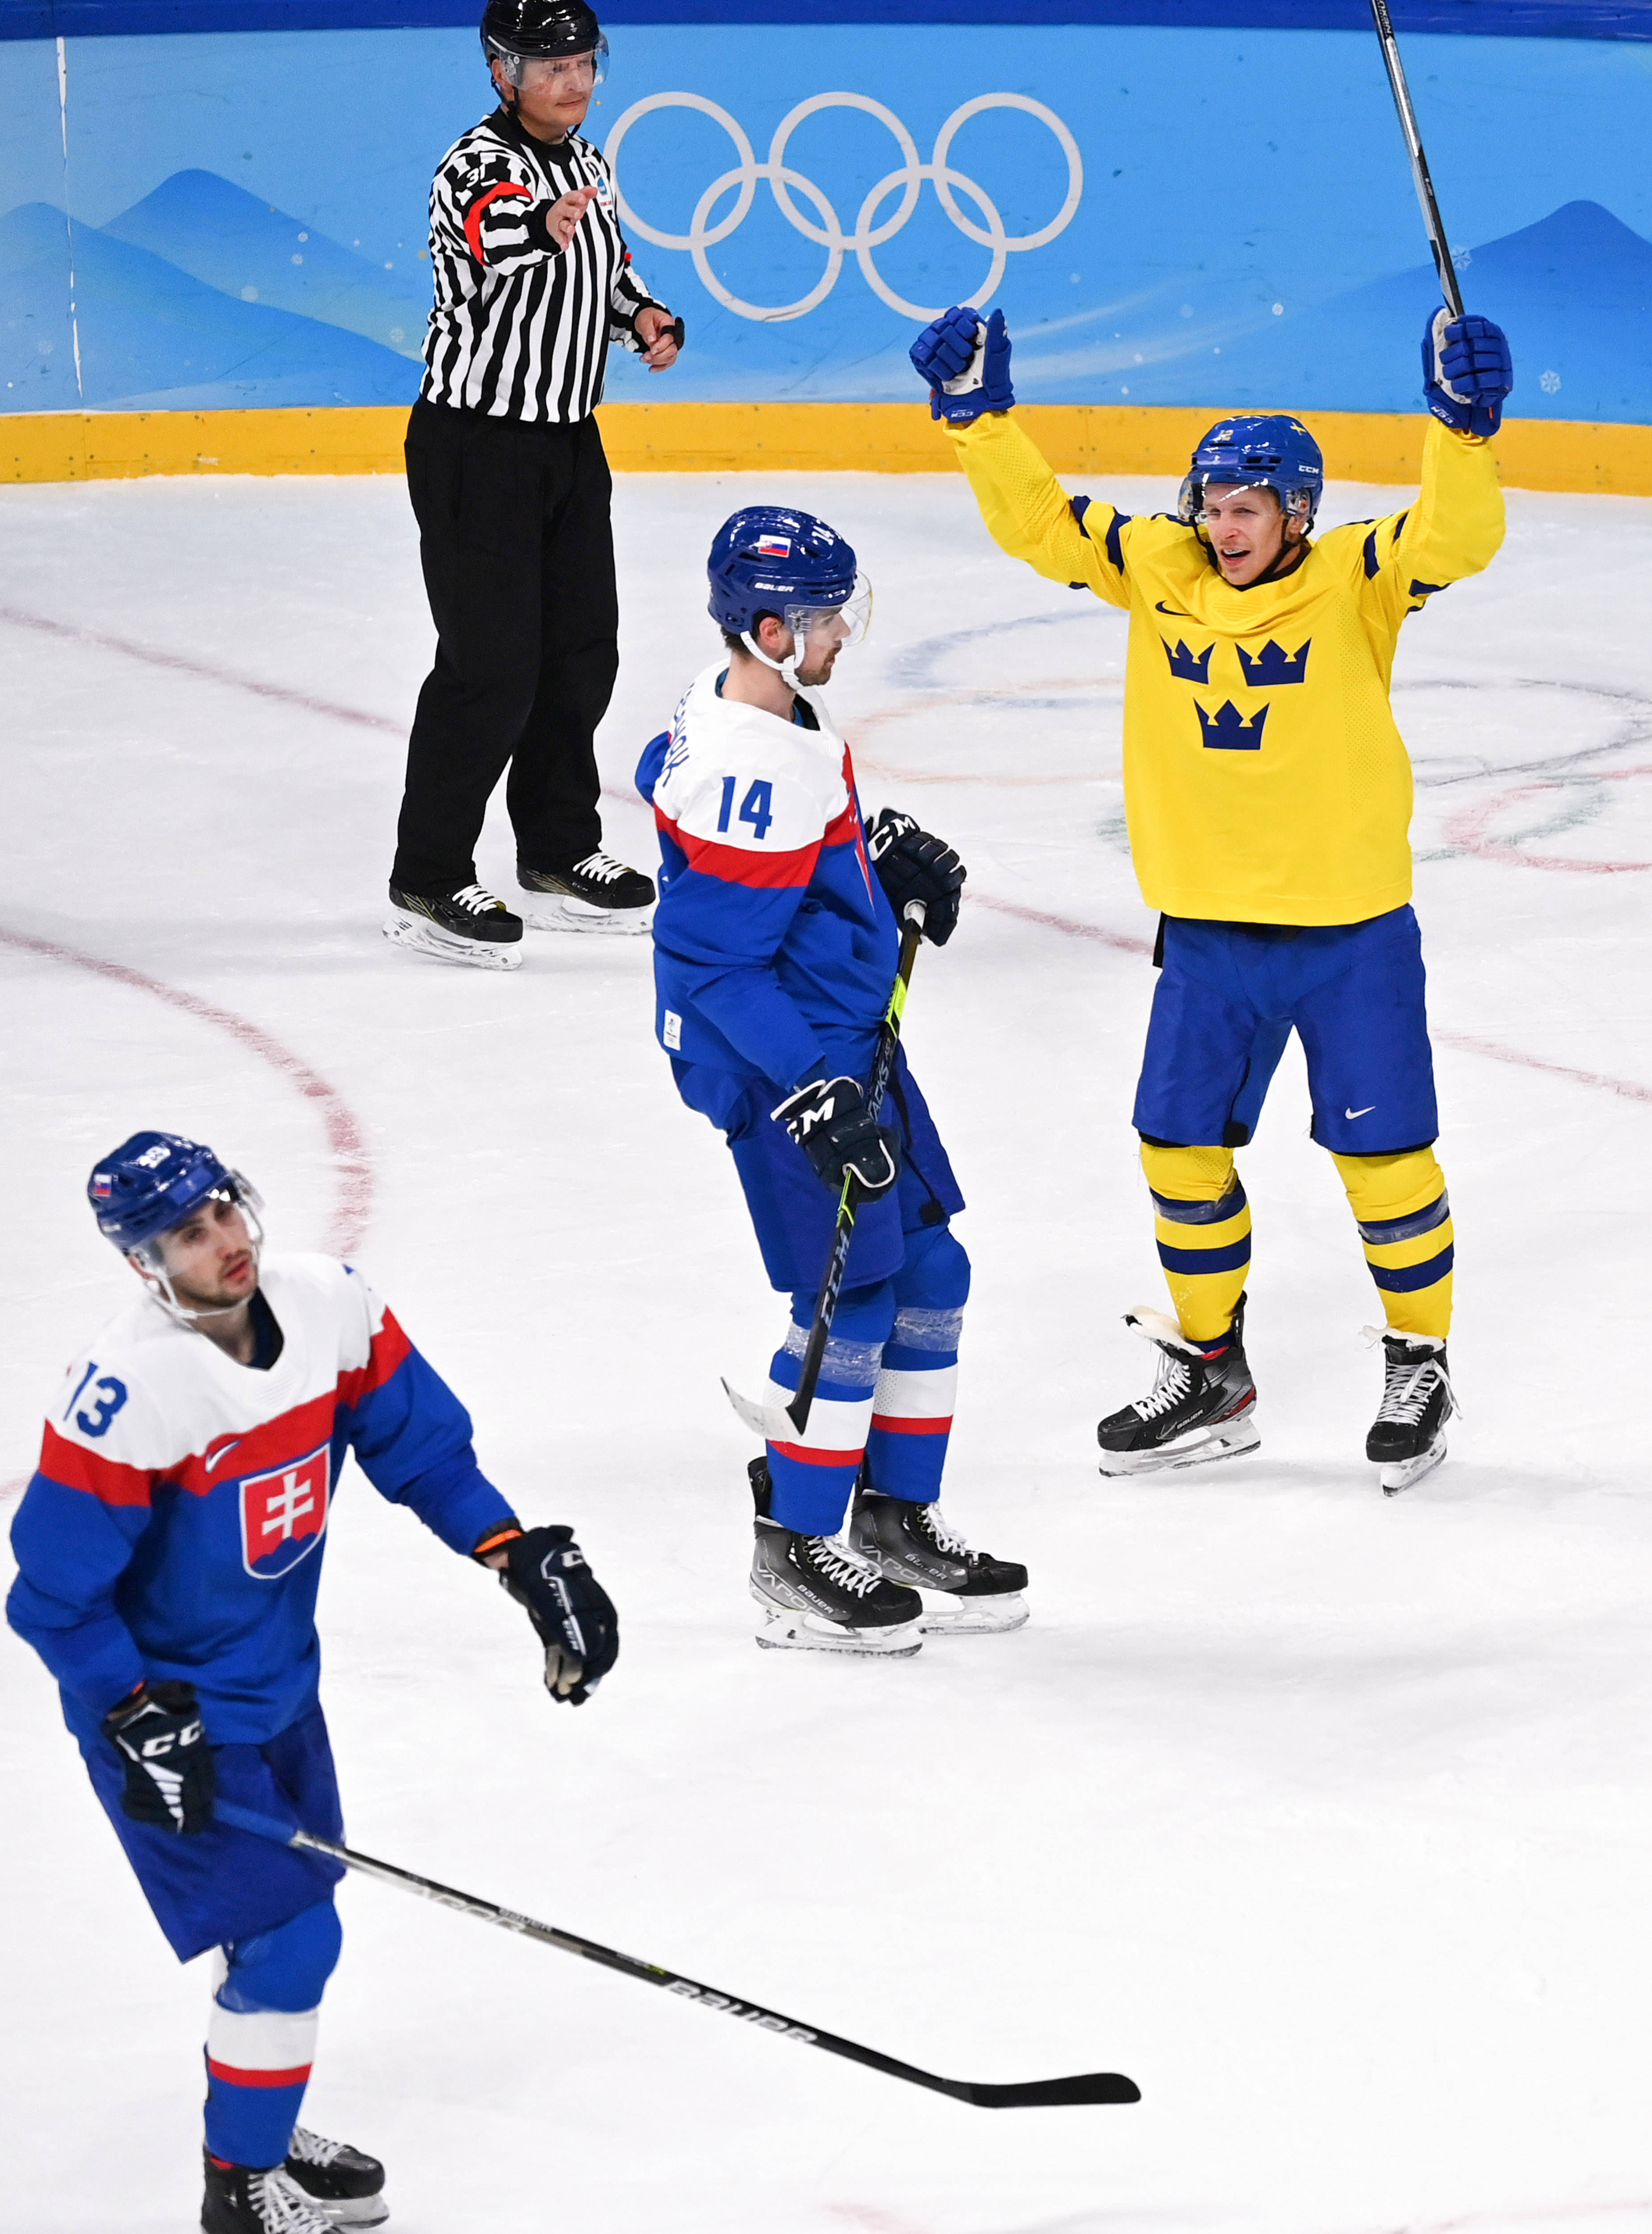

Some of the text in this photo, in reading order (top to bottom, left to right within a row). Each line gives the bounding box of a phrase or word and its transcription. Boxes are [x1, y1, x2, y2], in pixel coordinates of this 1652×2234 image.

[466, 163, 486, 188] 31
[1298, 465, 1320, 475] CCM
[754, 582, 795, 593] BAUER
[717, 776, 773, 840] 14
[867, 816, 916, 861] CM
[63, 1361, 129, 1438] 13
[1177, 1409, 1204, 1430] BAUER
[797, 1584, 834, 1614] BAUER
[141, 1719, 205, 1758] CC
